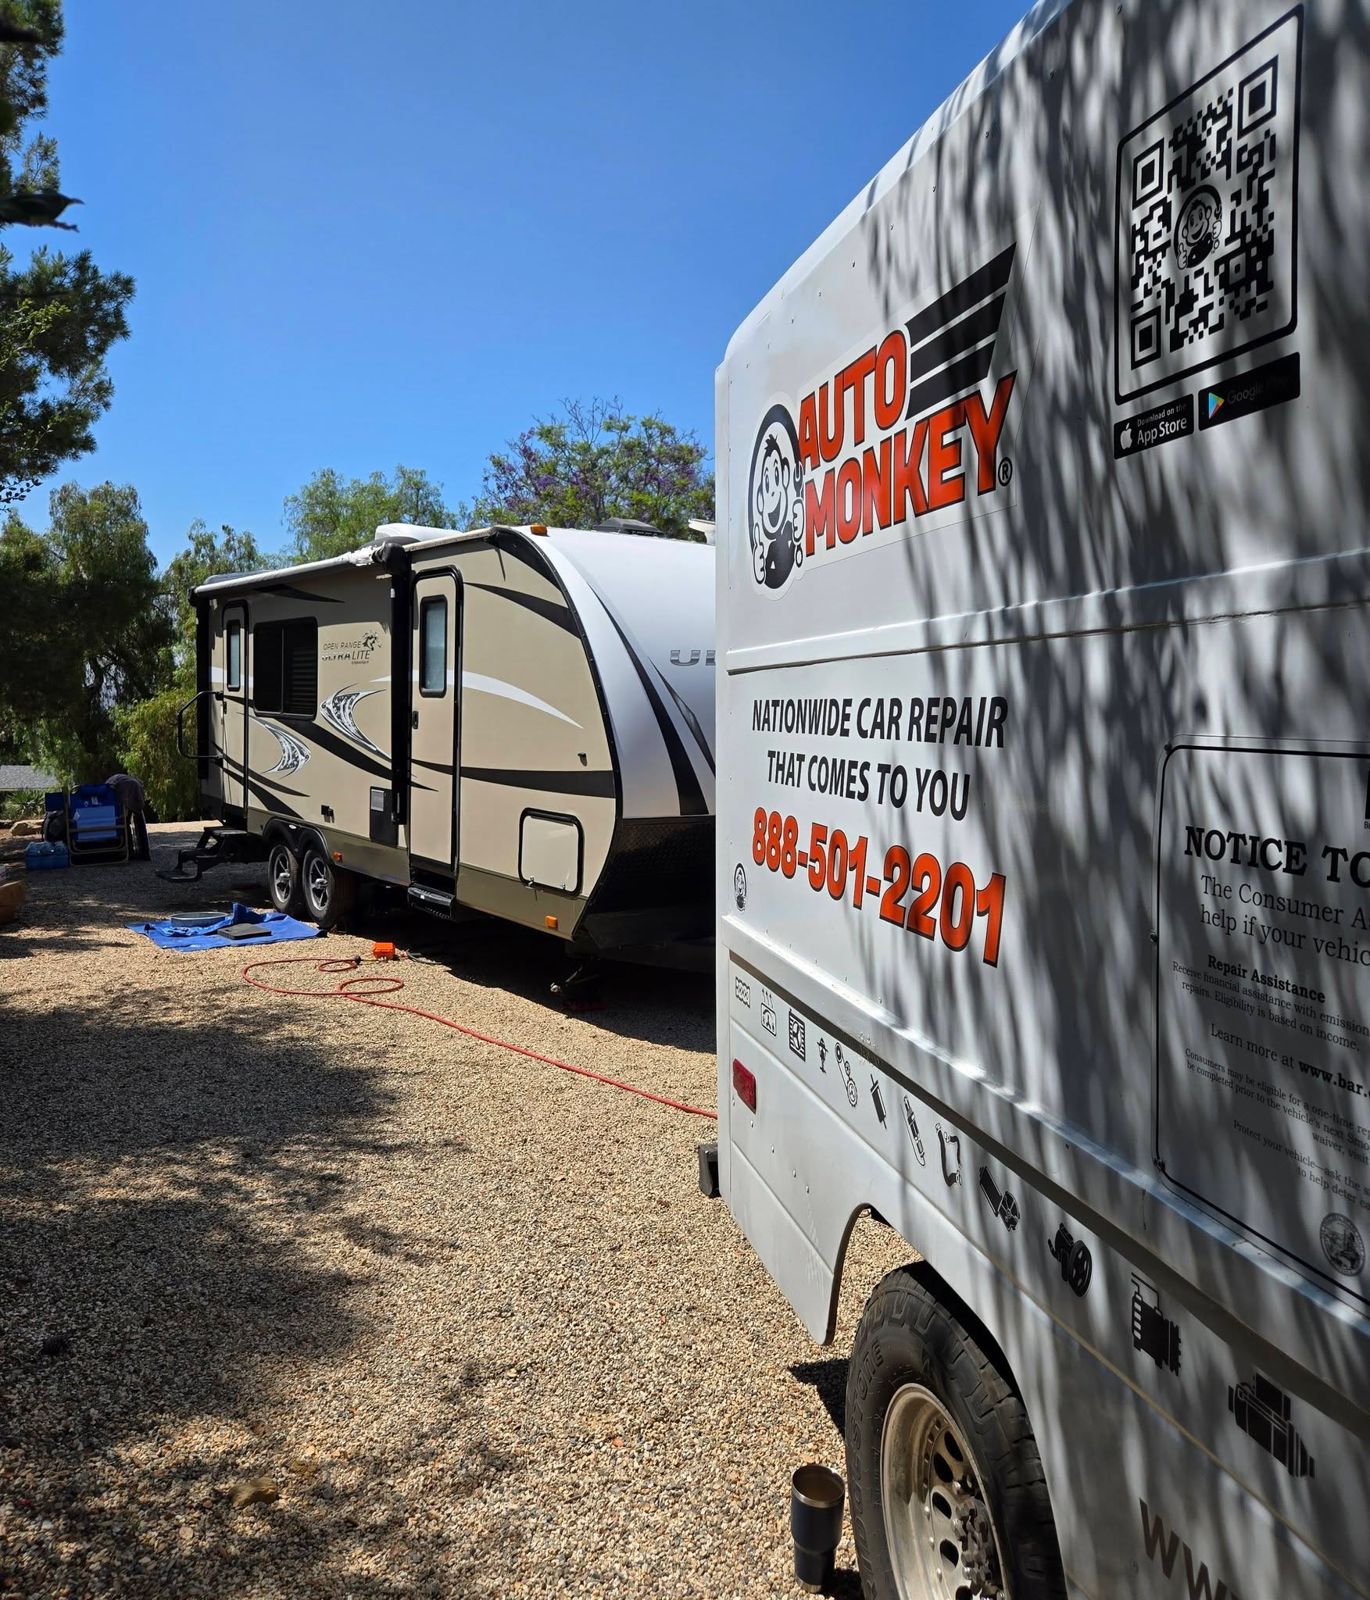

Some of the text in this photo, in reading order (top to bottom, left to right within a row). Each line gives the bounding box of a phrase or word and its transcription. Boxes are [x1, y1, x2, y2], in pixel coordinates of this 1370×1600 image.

[799, 330, 907, 474] AUTO
[1166, 408, 1175, 416] on
[1137, 417, 1187, 446] App Store
[805, 369, 1018, 558] MONKEY
[340, 641, 361, 649] RANGE
[752, 696, 1009, 748] NATIONWIDE CAR REPAIR
[767, 749, 971, 822] THAT COMES TO YOU
[1184, 825, 1308, 876] NOTICE
[752, 806, 1007, 968] 888-501-2201
[1200, 874, 1370, 931] The Consumer A
[1200, 904, 1237, 936] help
[1242, 914, 1257, 936] if
[1260, 922, 1307, 950] your
[1207, 954, 1326, 1004] Repair Assistance
[1242, 986, 1291, 1010] assistance
[1294, 1002, 1317, 1019] with
[1214, 990, 1255, 1016] Eligibility
[1256, 1006, 1266, 1018] is
[1268, 1009, 1297, 1029] based
[1300, 1023, 1313, 1036] on
[1316, 1025, 1360, 1052] income.
[1185, 1048, 1226, 1073] Consumers
[1227, 1068, 1244, 1081] may
[1289, 1093, 1301, 1106] for
[1303, 1102, 1309, 1111] a
[1186, 1060, 1195, 1071] be
[1196, 1067, 1234, 1089] completed
[1235, 1084, 1255, 1099] prior
[1256, 1093, 1265, 1103] to
[1267, 1098, 1281, 1110] the
[1210, 1023, 1370, 1098] Learn more at www.bar.
[1233, 1120, 1261, 1141] Protect
[1263, 1138, 1282, 1152] your
[1344, 1176, 1361, 1192] the
[1309, 1170, 1330, 1190] help
